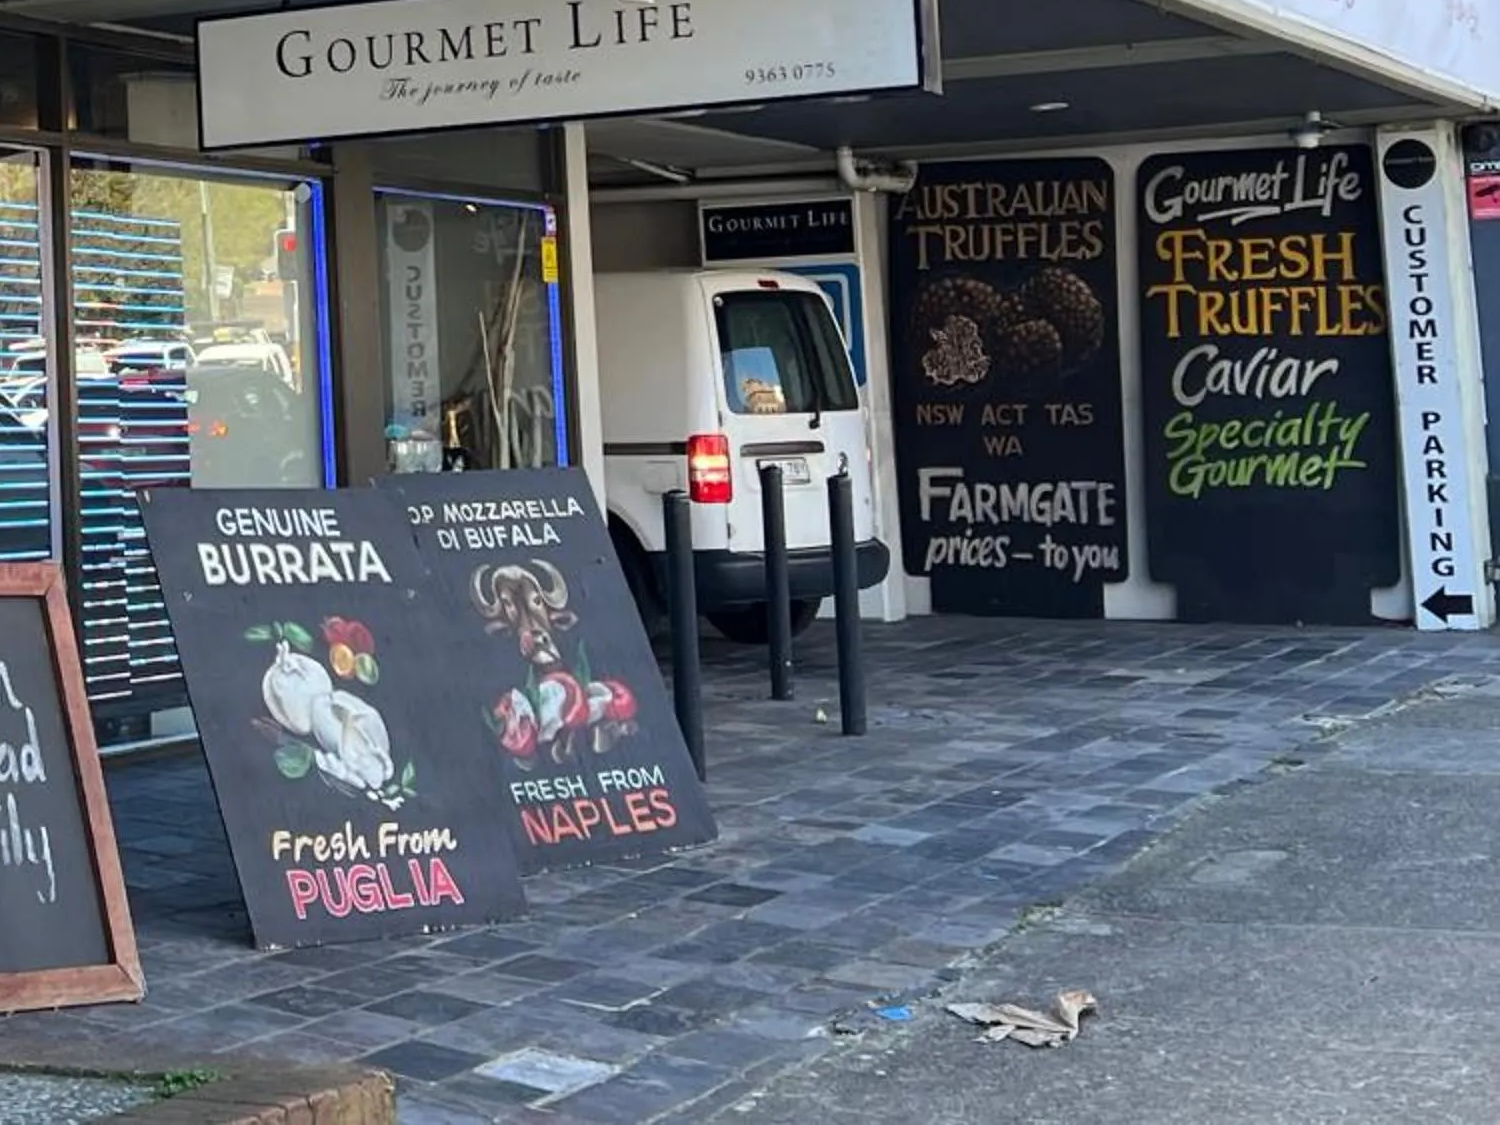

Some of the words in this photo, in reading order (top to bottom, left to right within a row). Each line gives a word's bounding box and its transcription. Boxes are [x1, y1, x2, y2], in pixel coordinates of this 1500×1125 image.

[275, 18, 543, 78] GOURMET
[567, 1, 695, 50] LIFE
[379, 77, 419, 101] The
[418, 75, 501, 105] journey
[509, 68, 532, 95] of
[535, 68, 583, 88] taste
[745, 65, 787, 85] 9363
[896, 179, 1107, 220] AUSTRALIAN
[1145, 161, 1289, 224] Gourmet
[1284, 152, 1362, 217] Life
[906, 221, 1104, 271] TRUFFLES
[1155, 228, 1357, 284] FRESH
[1146, 283, 1387, 338] TRUFFLES
[1172, 344, 1339, 407] Caviar
[1402, 205, 1438, 385] CUSTOMER
[1421, 412, 1456, 578] PARKING
[916, 404, 964, 425] NSW
[981, 403, 1028, 425] ACT
[1044, 403, 1094, 425] TAS
[1164, 401, 1371, 459] Specialty
[983, 435, 1024, 456] WA
[1169, 445, 1367, 499] Gourmet
[443, 497, 585, 524] MOZZARELLA
[918, 467, 1116, 526] FARMGATE
[216, 508, 342, 538] GENUINE
[436, 529, 461, 552] DI
[464, 523, 562, 549] BUFALA
[199, 541, 393, 586] BURRATA
[1072, 543, 1121, 583] you
[510, 774, 585, 805] FRESH
[598, 765, 665, 793] FROM
[520, 788, 677, 846] NAPLES
[272, 822, 371, 863] Fresh
[379, 823, 458, 858] From
[286, 857, 465, 920] PUGLIA
